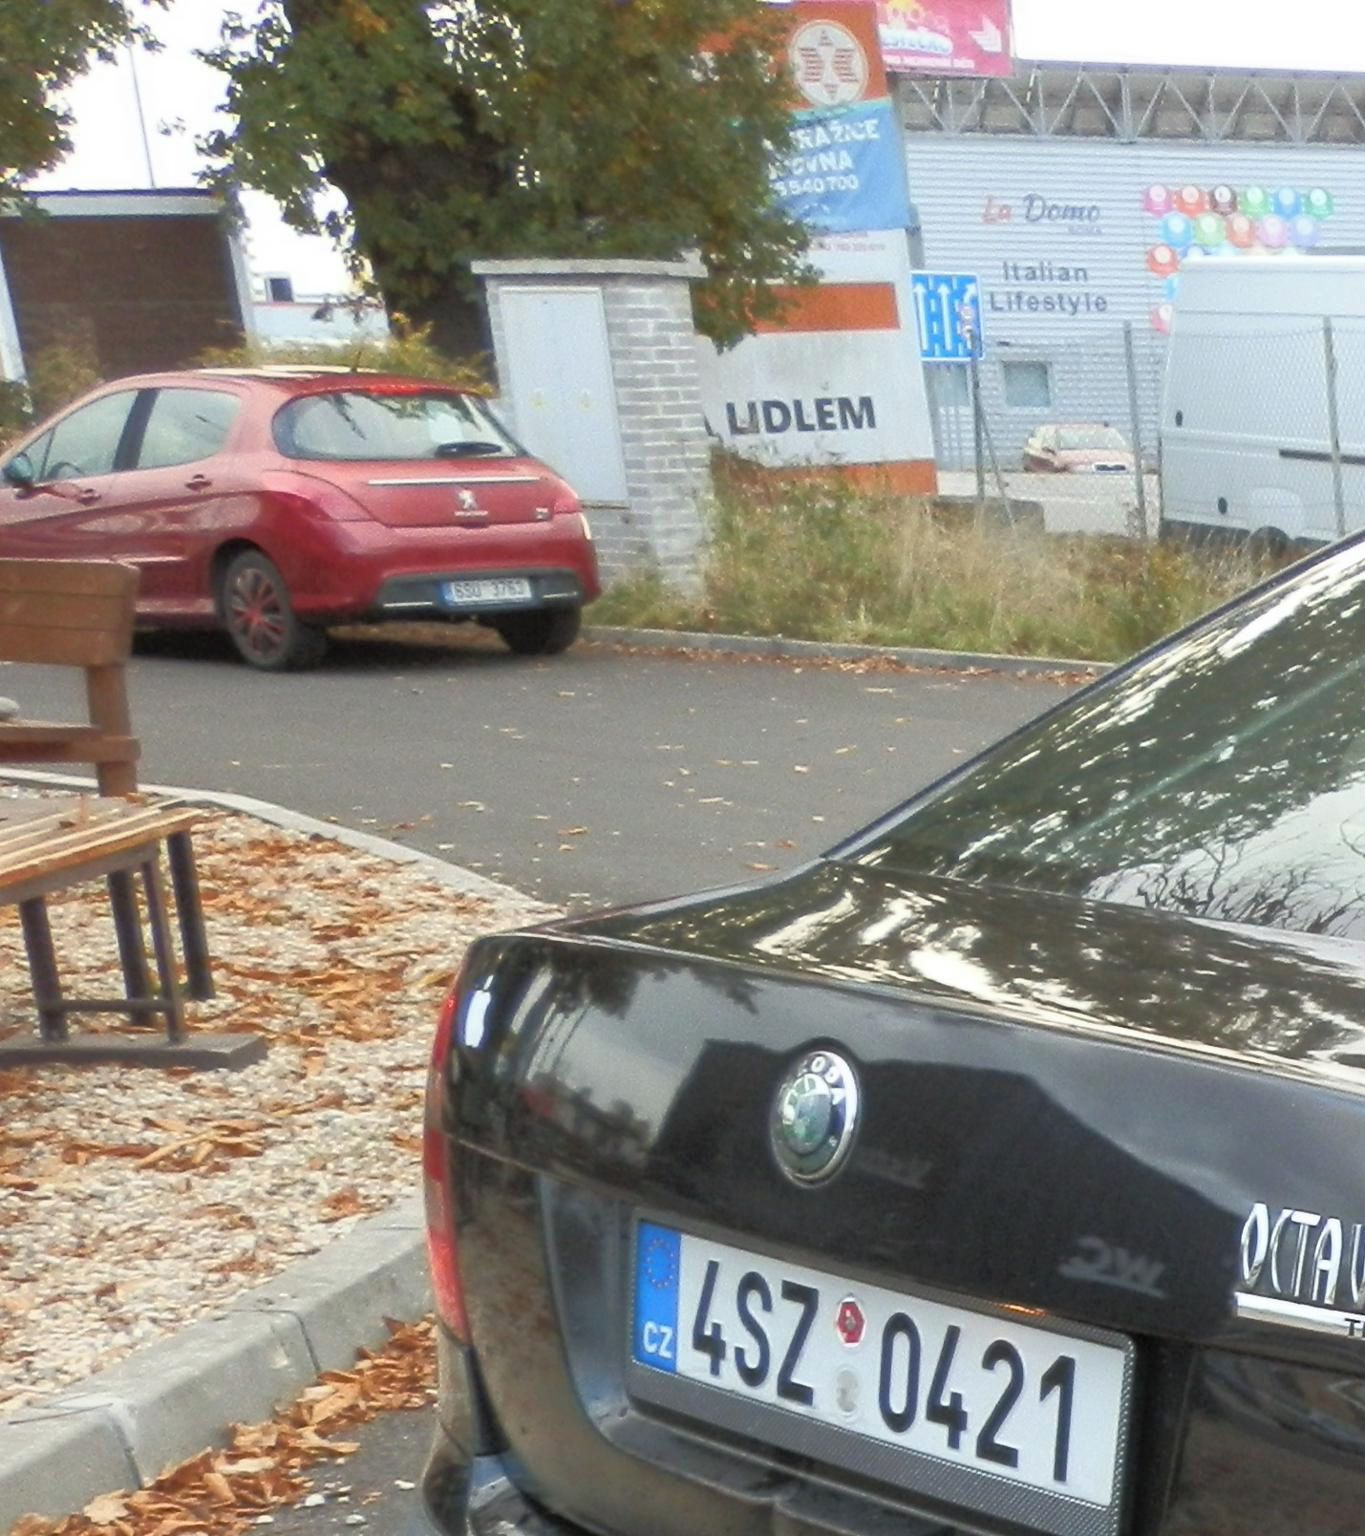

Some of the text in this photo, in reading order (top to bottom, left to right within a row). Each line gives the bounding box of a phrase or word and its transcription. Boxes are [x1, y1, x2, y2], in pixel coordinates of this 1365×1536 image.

[981, 192, 1101, 225] La Domo
[1002, 260, 1089, 282] Italian
[989, 291, 1108, 317] Lifestyle
[726, 396, 877, 436] LIDLEM
[642, 1319, 674, 1360] CZ
[692, 1259, 1077, 1483] 4SZ 0421
